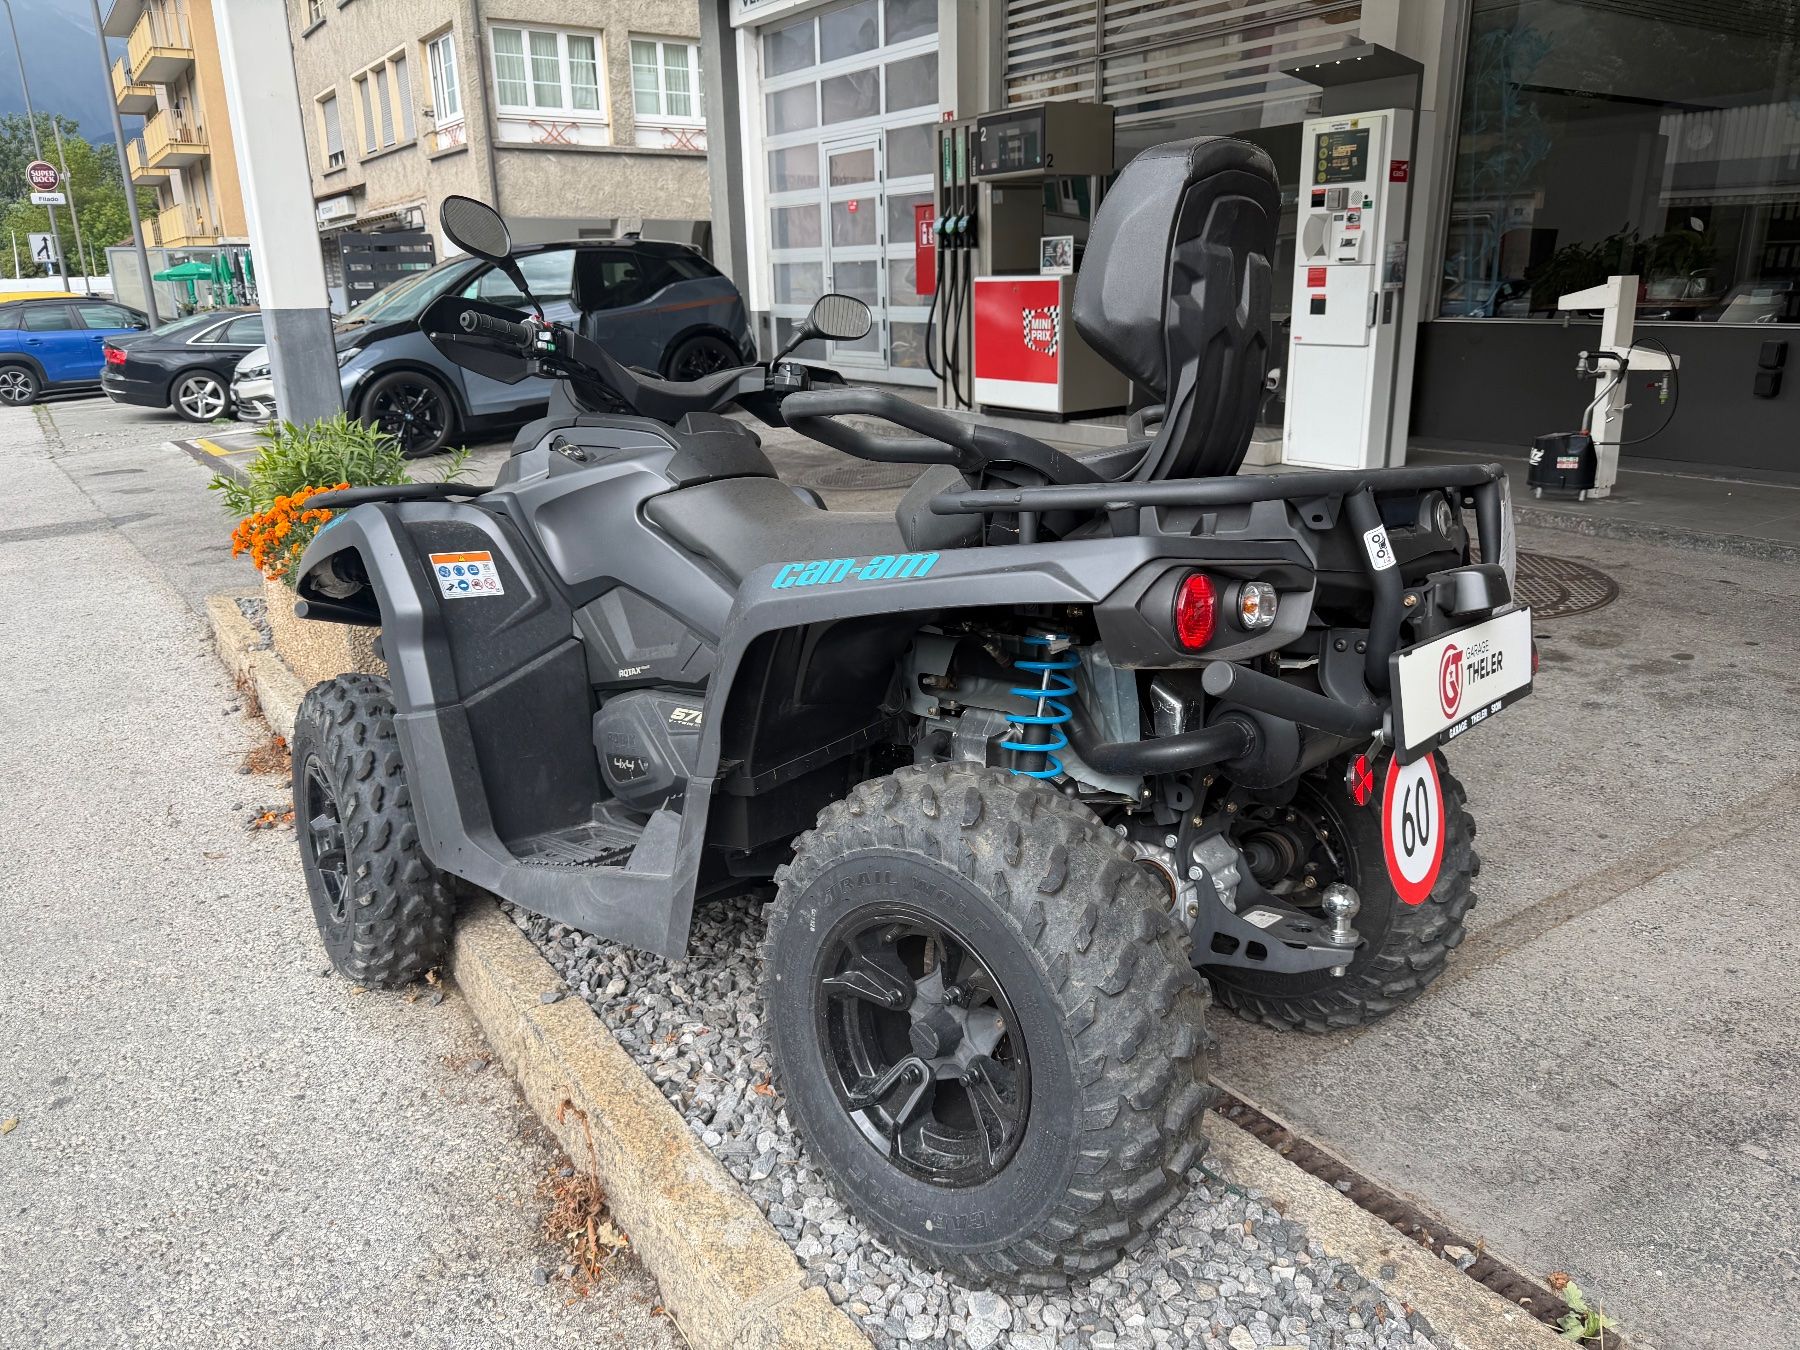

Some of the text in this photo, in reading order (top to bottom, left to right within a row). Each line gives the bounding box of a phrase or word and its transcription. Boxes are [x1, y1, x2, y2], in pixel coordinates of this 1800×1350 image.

[980, 127, 987, 142] 2
[1046, 153, 1054, 168] 2
[1031, 318, 1052, 330] MINI
[1031, 330, 1052, 341] PRIX
[771, 552, 940, 589] can-am
[1466, 639, 1489, 660] GARAGE
[618, 666, 642, 678] ROTAX
[1466, 650, 1503, 685] THELER
[1448, 719, 1468, 739] GARAGE
[1470, 708, 1488, 726] THELER
[613, 757, 635, 770] 4x4
[1401, 776, 1430, 858] 60
[824, 870, 899, 903] TRAIL
